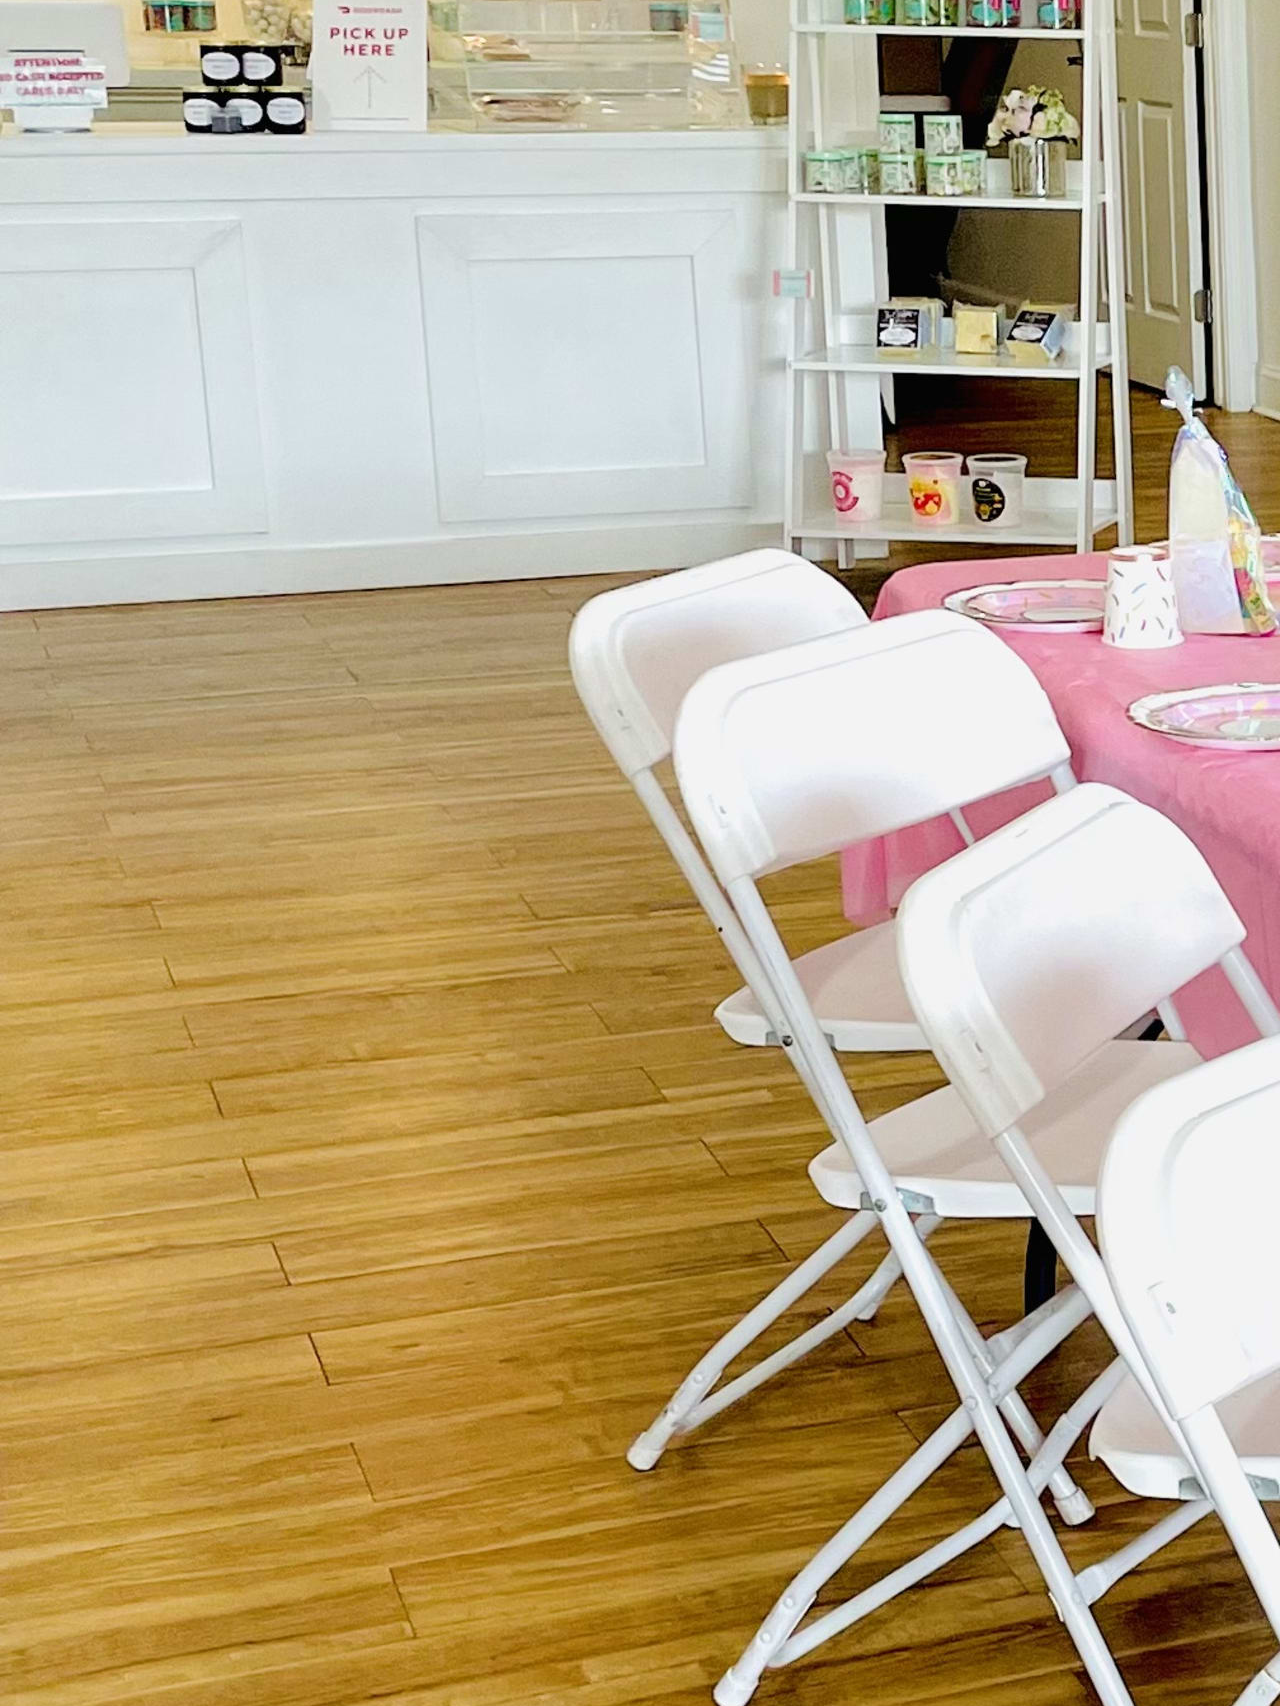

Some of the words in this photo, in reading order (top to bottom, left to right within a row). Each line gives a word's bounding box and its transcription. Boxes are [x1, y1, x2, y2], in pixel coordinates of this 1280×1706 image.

[329, 26, 375, 40] PICK
[383, 27, 409, 40] UP
[343, 43, 396, 57] HERE
